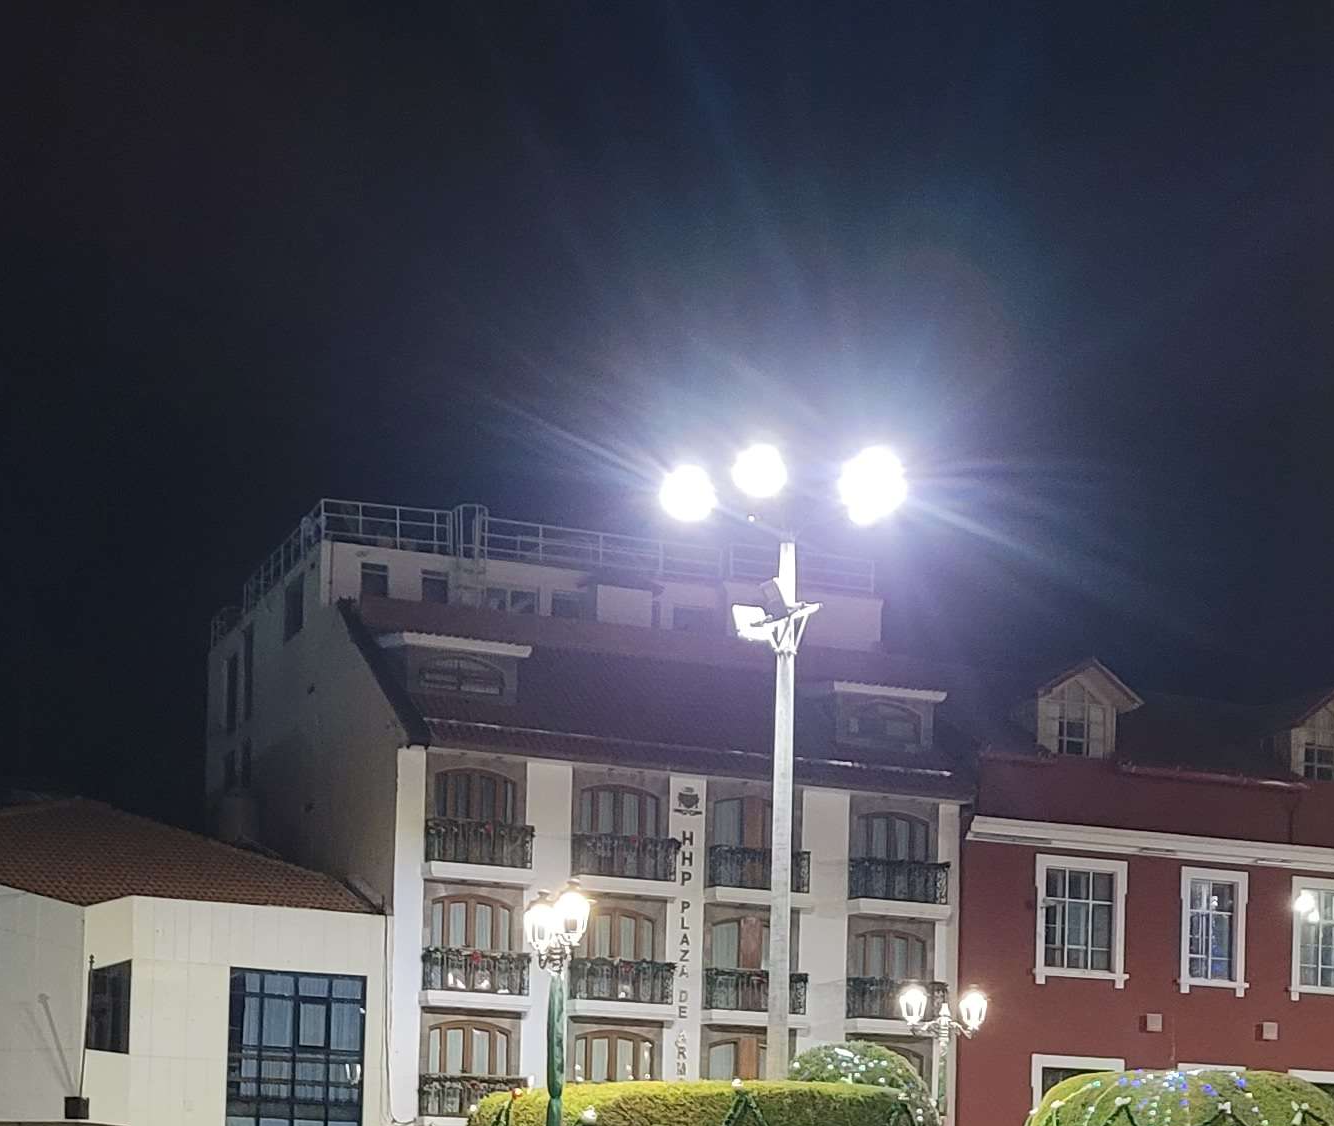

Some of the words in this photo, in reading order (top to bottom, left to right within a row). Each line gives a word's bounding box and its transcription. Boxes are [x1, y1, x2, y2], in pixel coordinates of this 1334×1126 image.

[681, 830, 693, 886] HHP
[679, 901, 691, 978] PLAZA
[678, 990, 688, 1018] DE
[675, 1030, 687, 1080] ARM
